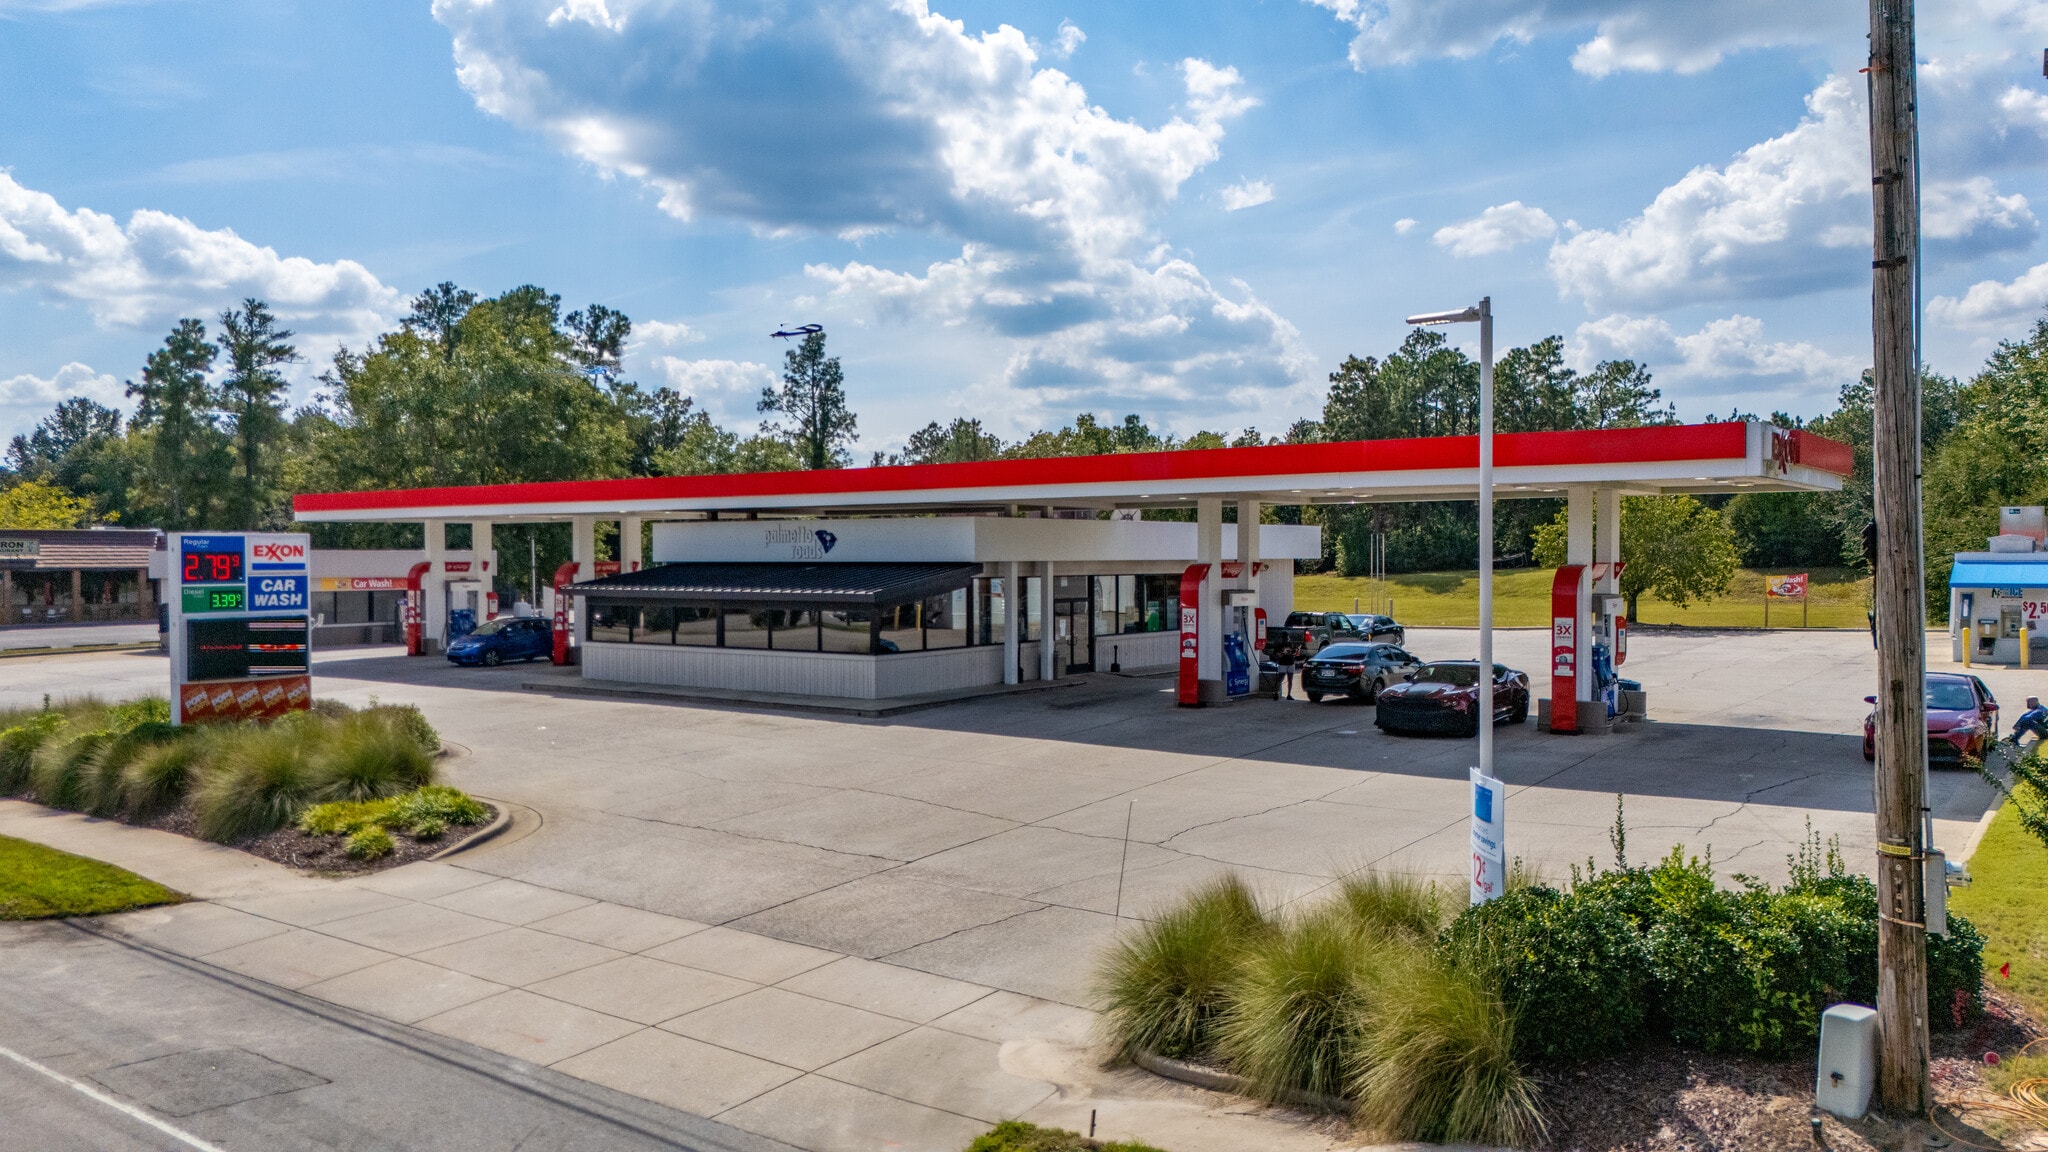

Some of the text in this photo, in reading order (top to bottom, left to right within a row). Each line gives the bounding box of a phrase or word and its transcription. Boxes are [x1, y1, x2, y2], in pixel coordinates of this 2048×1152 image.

[765, 524, 813, 548] palmetto
[253, 543, 304, 562] EXXON
[261, 579, 296, 592] CAR
[353, 579, 392, 588] Car Wash!
[254, 593, 302, 607] WASH
[1183, 615, 1195, 624] 3X
[1555, 625, 1572, 635] 3X
